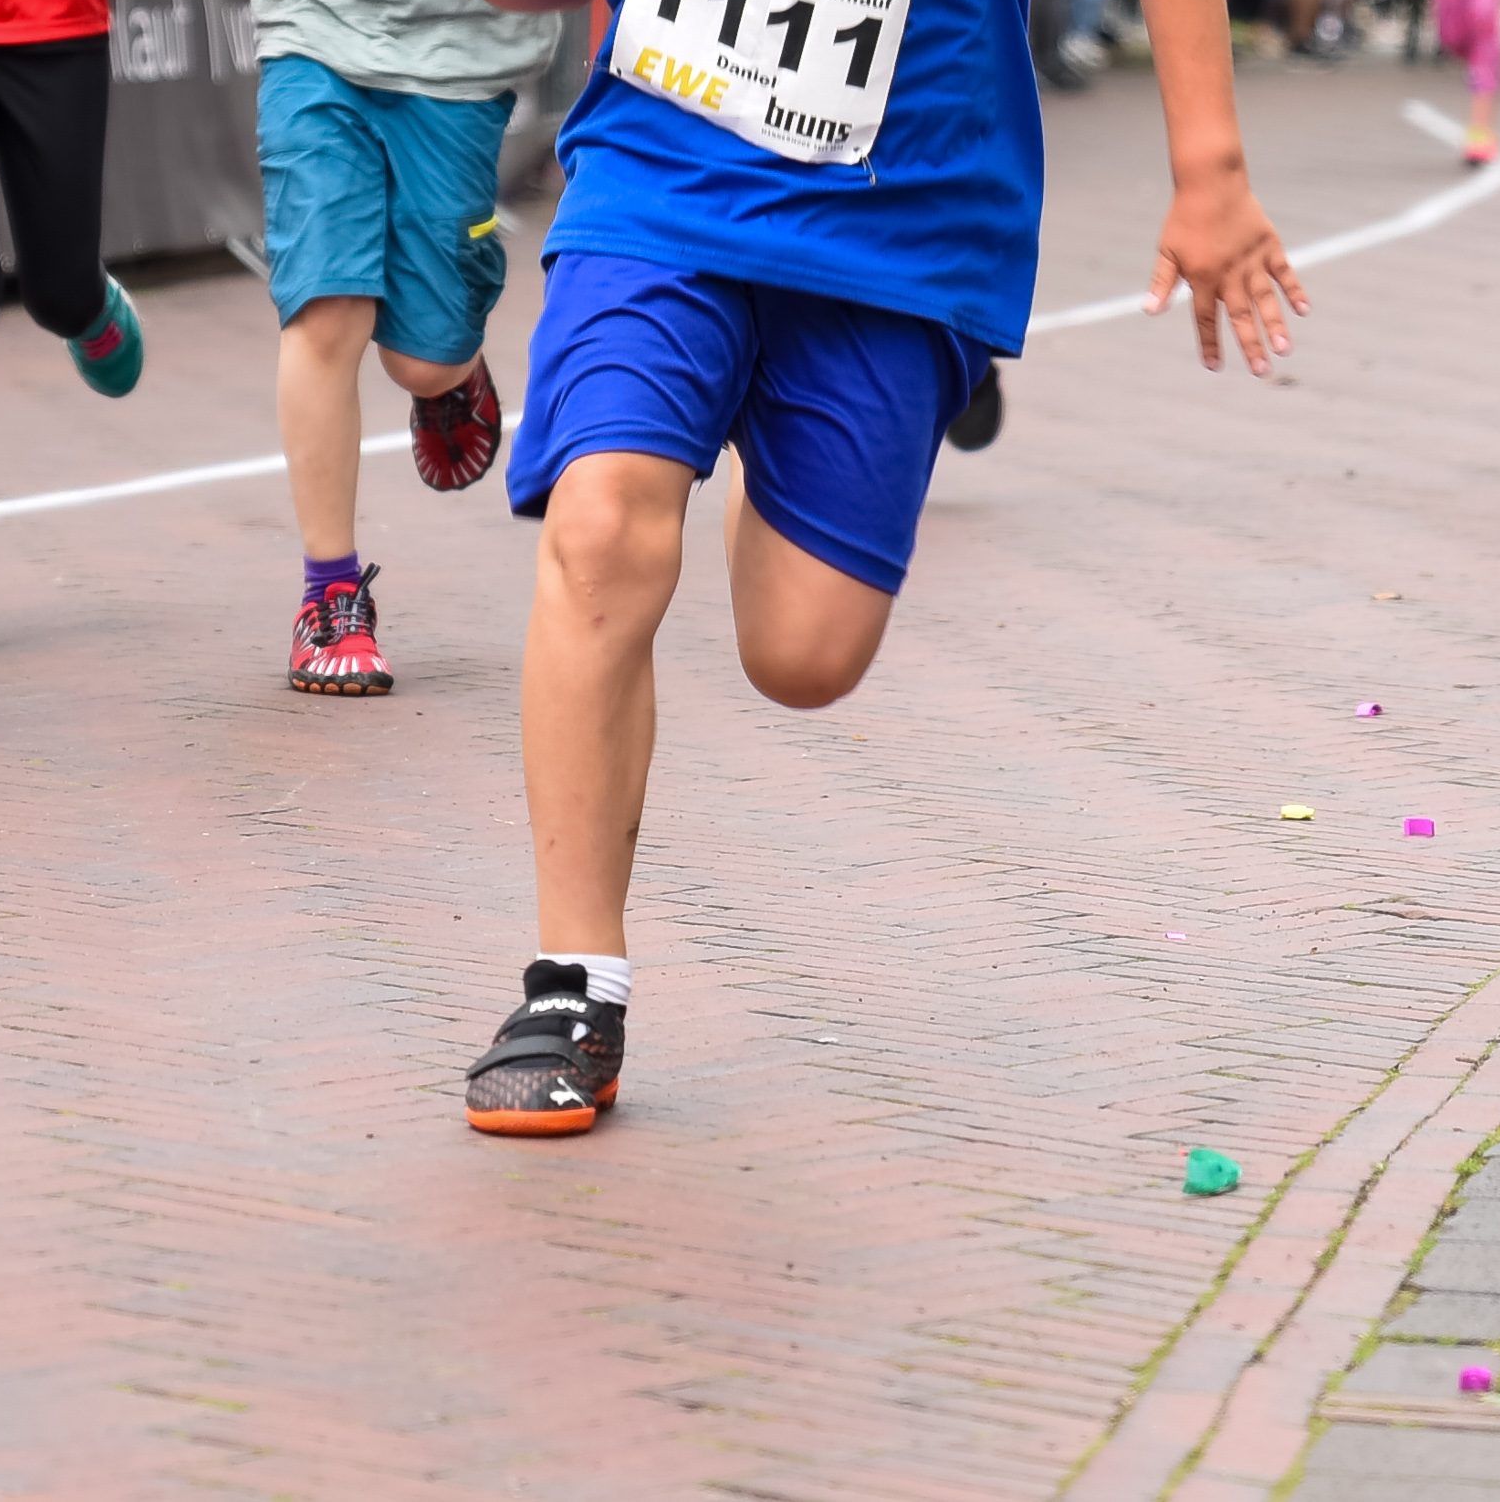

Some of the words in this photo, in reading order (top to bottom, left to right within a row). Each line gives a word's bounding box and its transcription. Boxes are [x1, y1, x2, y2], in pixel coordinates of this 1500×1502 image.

[632, 47, 730, 111] EWE
[765, 95, 852, 142] bruns
[716, 54, 778, 89] Daniel
